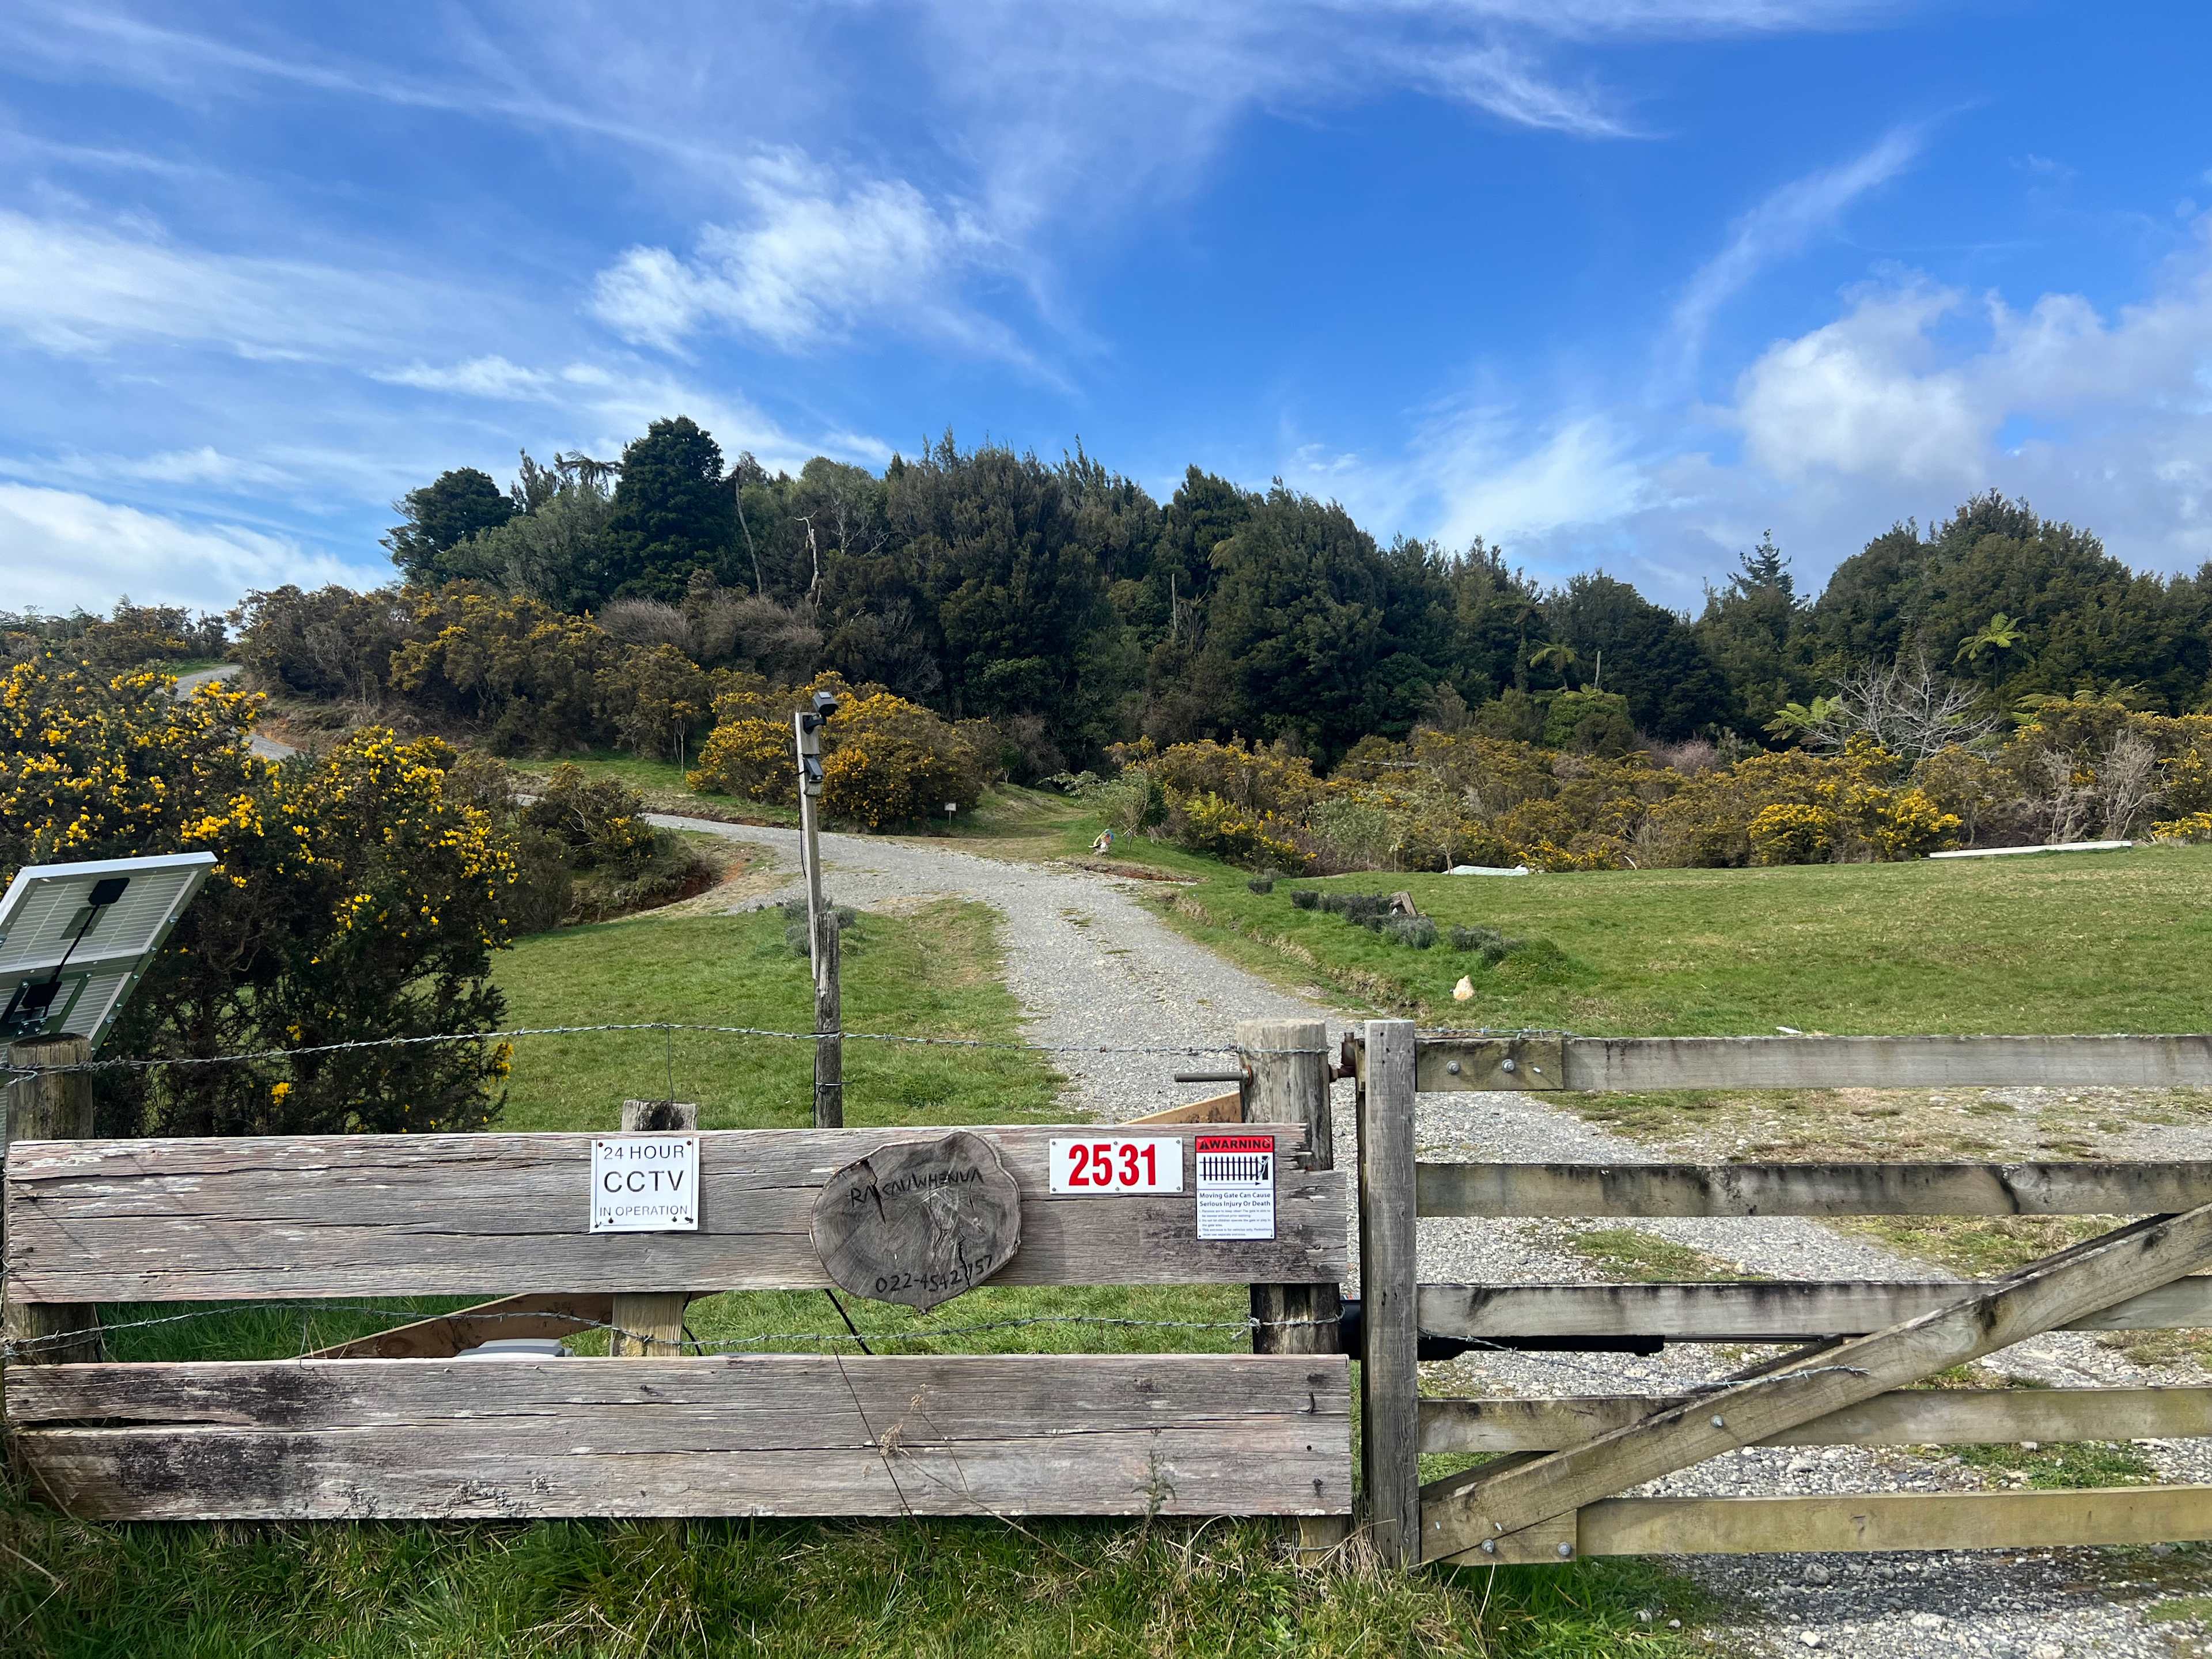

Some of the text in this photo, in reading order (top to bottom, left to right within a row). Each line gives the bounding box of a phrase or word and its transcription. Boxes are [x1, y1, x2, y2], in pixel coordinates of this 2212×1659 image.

[1210, 1139, 1270, 1149] WARNING
[604, 1145, 684, 1160] 24 HOUR
[1069, 1144, 1156, 1186] 2531
[604, 1170, 684, 1192] CCTV
[600, 1205, 687, 1217] IN OPERATION
